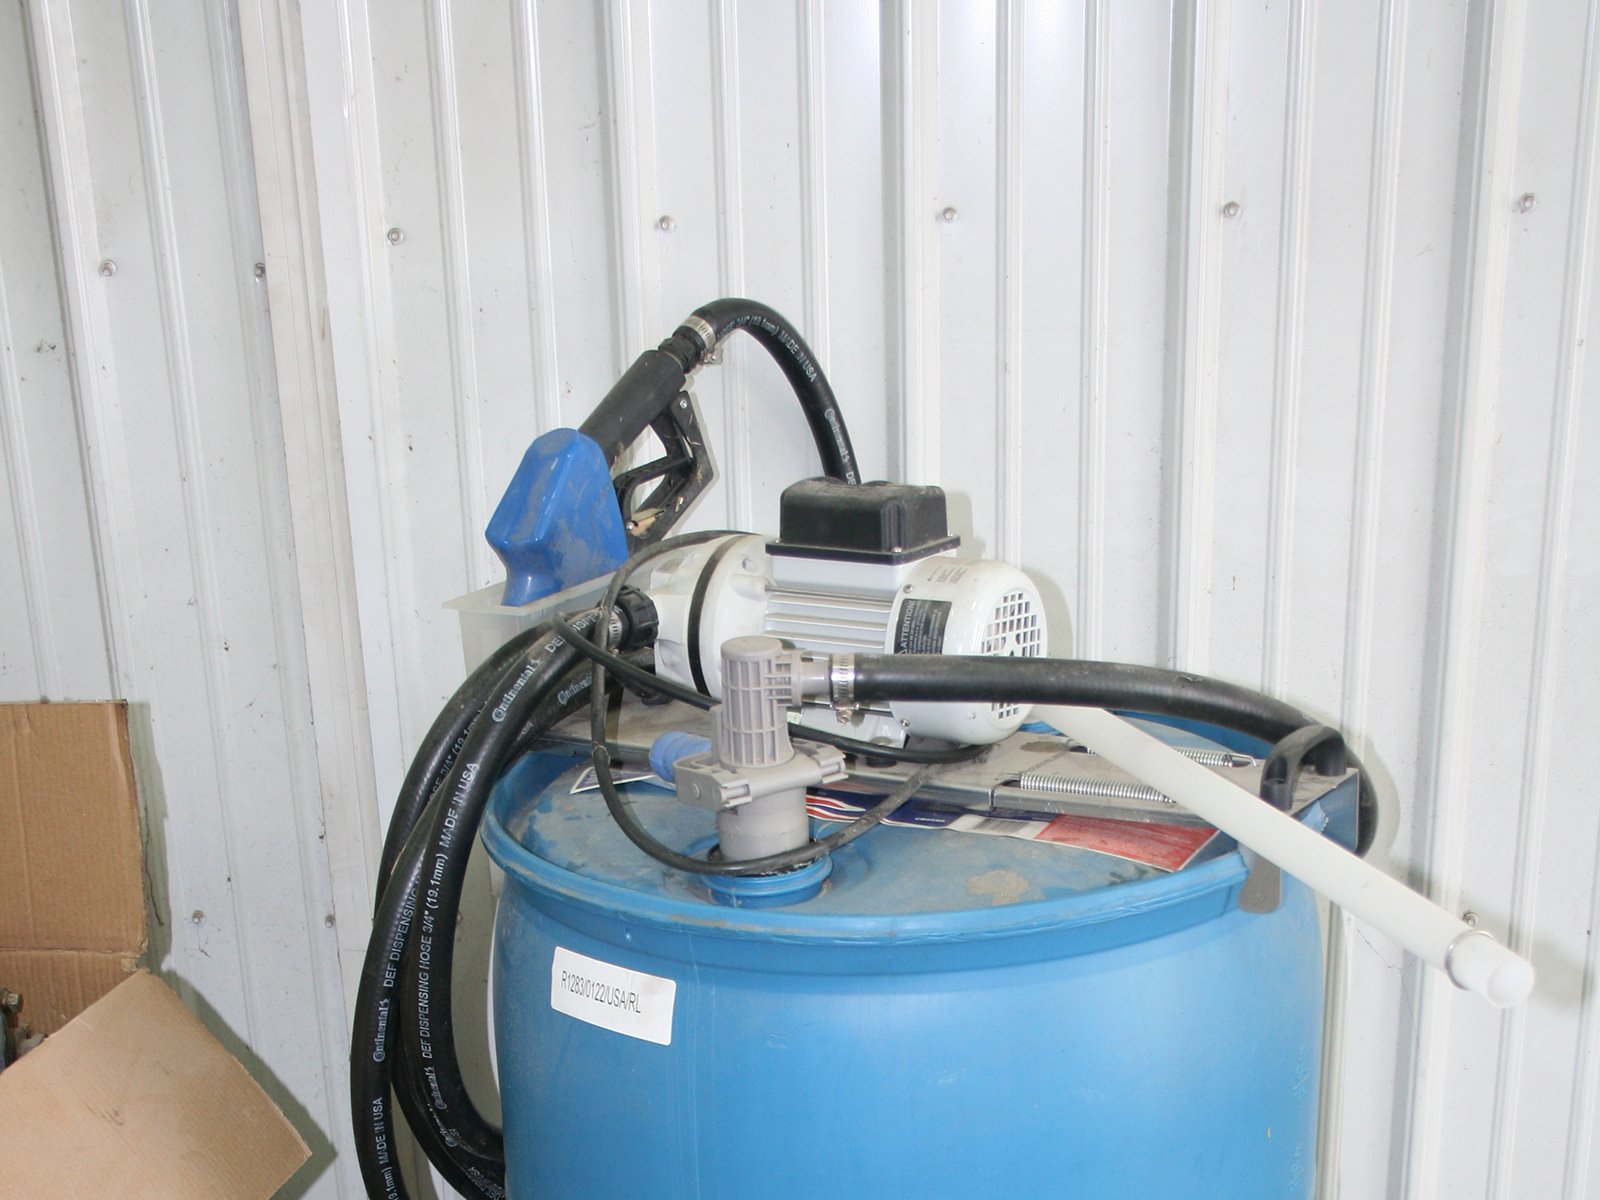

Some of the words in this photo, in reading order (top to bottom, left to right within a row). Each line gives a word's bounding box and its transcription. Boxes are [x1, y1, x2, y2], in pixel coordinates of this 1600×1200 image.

[802, 360, 817, 383] USA
[846, 471, 857, 486] DE
[491, 663, 537, 722] Continental
[457, 761, 480, 791] USA
[451, 790, 467, 808] IN
[439, 808, 459, 848] MADE
[426, 853, 449, 910] (19.1mm)
[422, 909, 435, 934] 3/4"
[419, 935, 432, 970] HOSE
[418, 971, 430, 1038] DISPENSING
[561, 970, 641, 1014] R1283/0122/USA/RL
[372, 1003, 388, 1062] Continental
[382, 963, 398, 988] DEF
[420, 1038, 433, 1059] DEF
[372, 1097, 384, 1120] USA
[374, 1121, 385, 1134] IN
[376, 1134, 389, 1164] MADE
